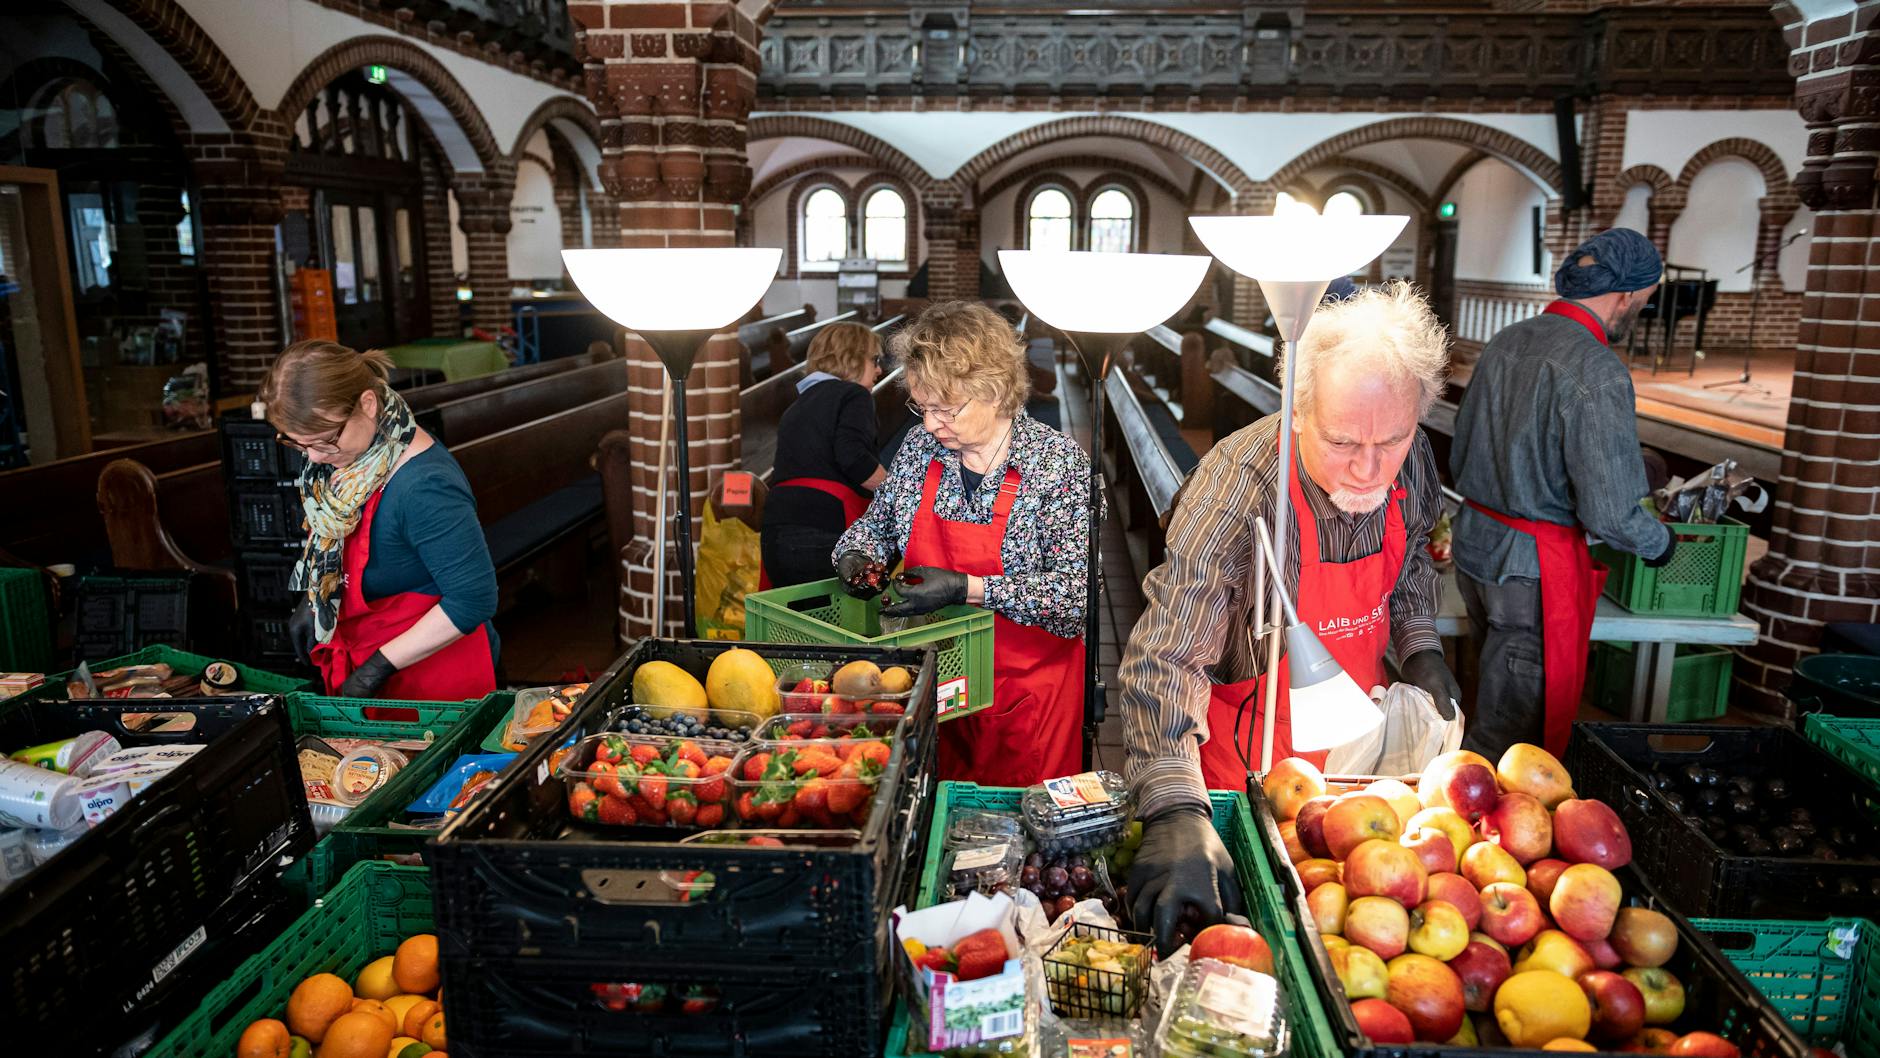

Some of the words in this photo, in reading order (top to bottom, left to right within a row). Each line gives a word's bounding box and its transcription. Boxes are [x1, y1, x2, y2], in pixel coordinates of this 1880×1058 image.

[1318, 617, 1350, 631] LAIB
[1352, 616, 1369, 626] UND
[87, 797, 113, 809] alpro
[175, 936, 195, 958] IFCO
